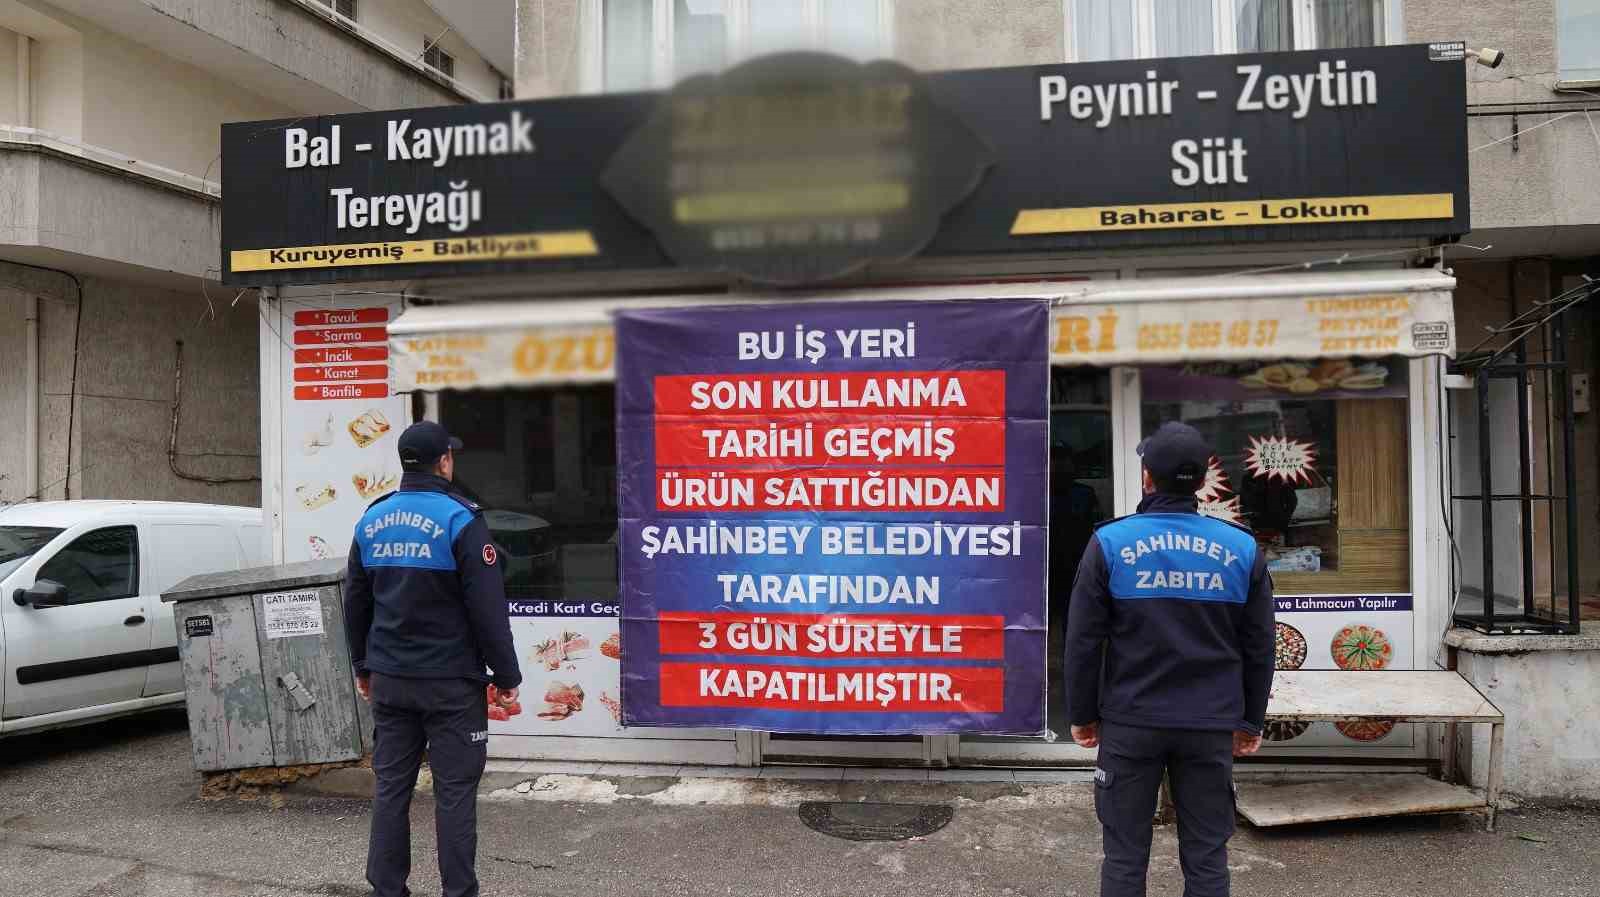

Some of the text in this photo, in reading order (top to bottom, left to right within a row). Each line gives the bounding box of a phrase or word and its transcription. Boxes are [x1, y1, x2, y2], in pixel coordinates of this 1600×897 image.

[1040, 70, 1178, 127] Peynir
[1236, 60, 1377, 118] Zeytin
[285, 125, 340, 168] Bal
[387, 111, 535, 166] Kaymak
[1171, 137, 1248, 186] Süt
[331, 180, 481, 232] Tereyağı
[1100, 208, 1225, 227] Baharat
[1261, 201, 1370, 220] Lokum
[270, 243, 405, 265] Kuruyemiş
[433, 236, 543, 255] Bakliyat
[322, 311, 359, 323] Tavuk
[324, 330, 362, 341] Sarma
[738, 322, 916, 364] BU İŞ YERİ
[325, 349, 353, 362] İncik
[324, 367, 359, 378] Kanat
[321, 385, 361, 397] Bonfile
[690, 378, 967, 410] SON KULLANMA
[702, 421, 956, 462] TARİHİ GEÇMİŞ
[661, 471, 999, 508] ÜRÜN SATTIĞINDAN
[364, 510, 445, 540] ŞAHİNBEY
[640, 520, 1021, 559] ŞAHİNBEY BELEDİYESİ
[372, 542, 433, 559] ZABITA
[1120, 531, 1239, 567] ŞAHİNBEY
[717, 574, 940, 605] TARAFINDAN
[1135, 570, 1225, 591] ZABITA
[508, 602, 549, 614] Kredi
[553, 602, 586, 614] Kart
[1278, 597, 1397, 611] ve Lahmacun Yapılır
[698, 617, 962, 653] 3 GÜN SÜREYLE
[699, 669, 962, 707] KAPATILMIŞTIR.
